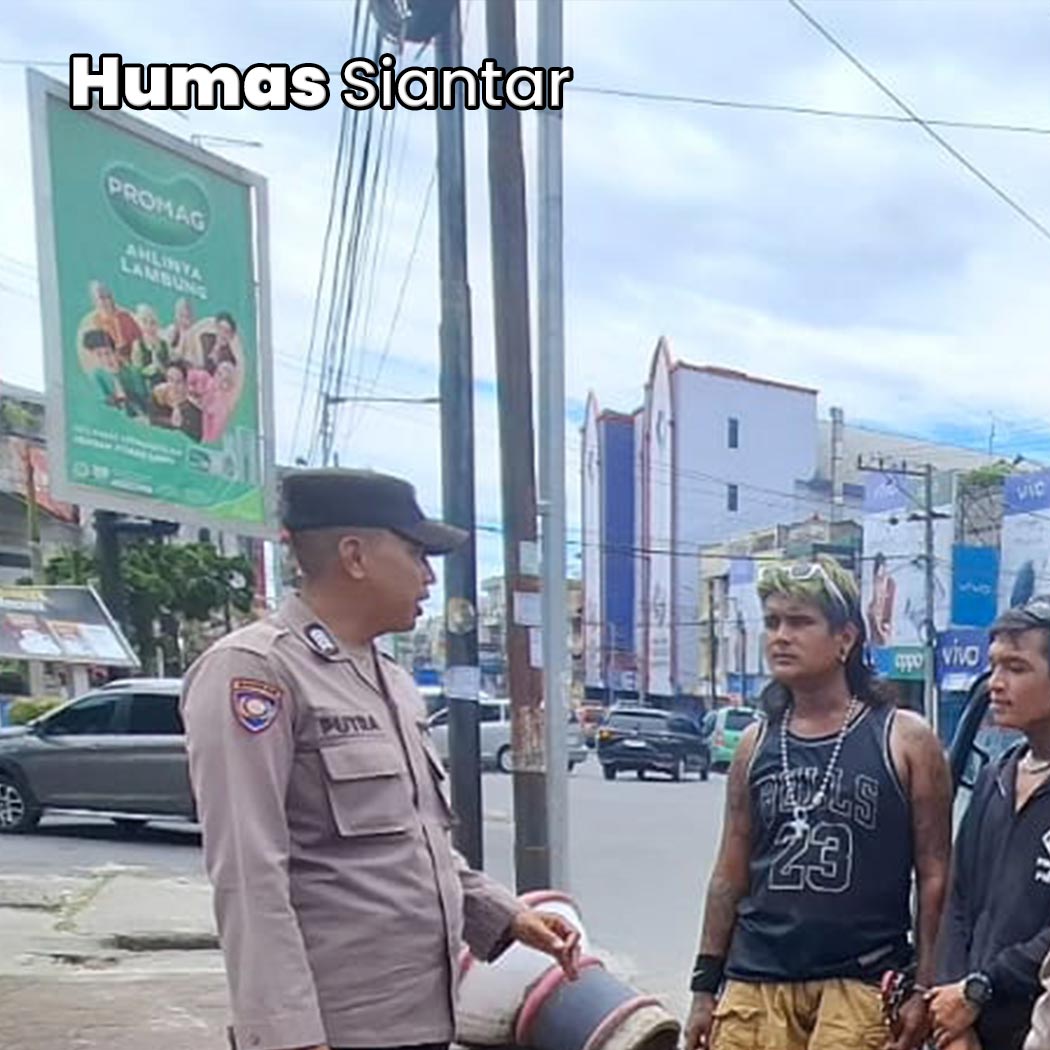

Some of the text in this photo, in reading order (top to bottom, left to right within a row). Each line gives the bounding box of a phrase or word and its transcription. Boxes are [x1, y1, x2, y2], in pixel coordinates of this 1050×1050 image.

[107, 176, 205, 231] PROMAG
[120, 256, 208, 299] LAMBUNG
[125, 244, 202, 281] AHLINYA
[942, 638, 980, 667] vivo
[319, 714, 381, 735] PUTRA
[768, 821, 853, 892] 23
